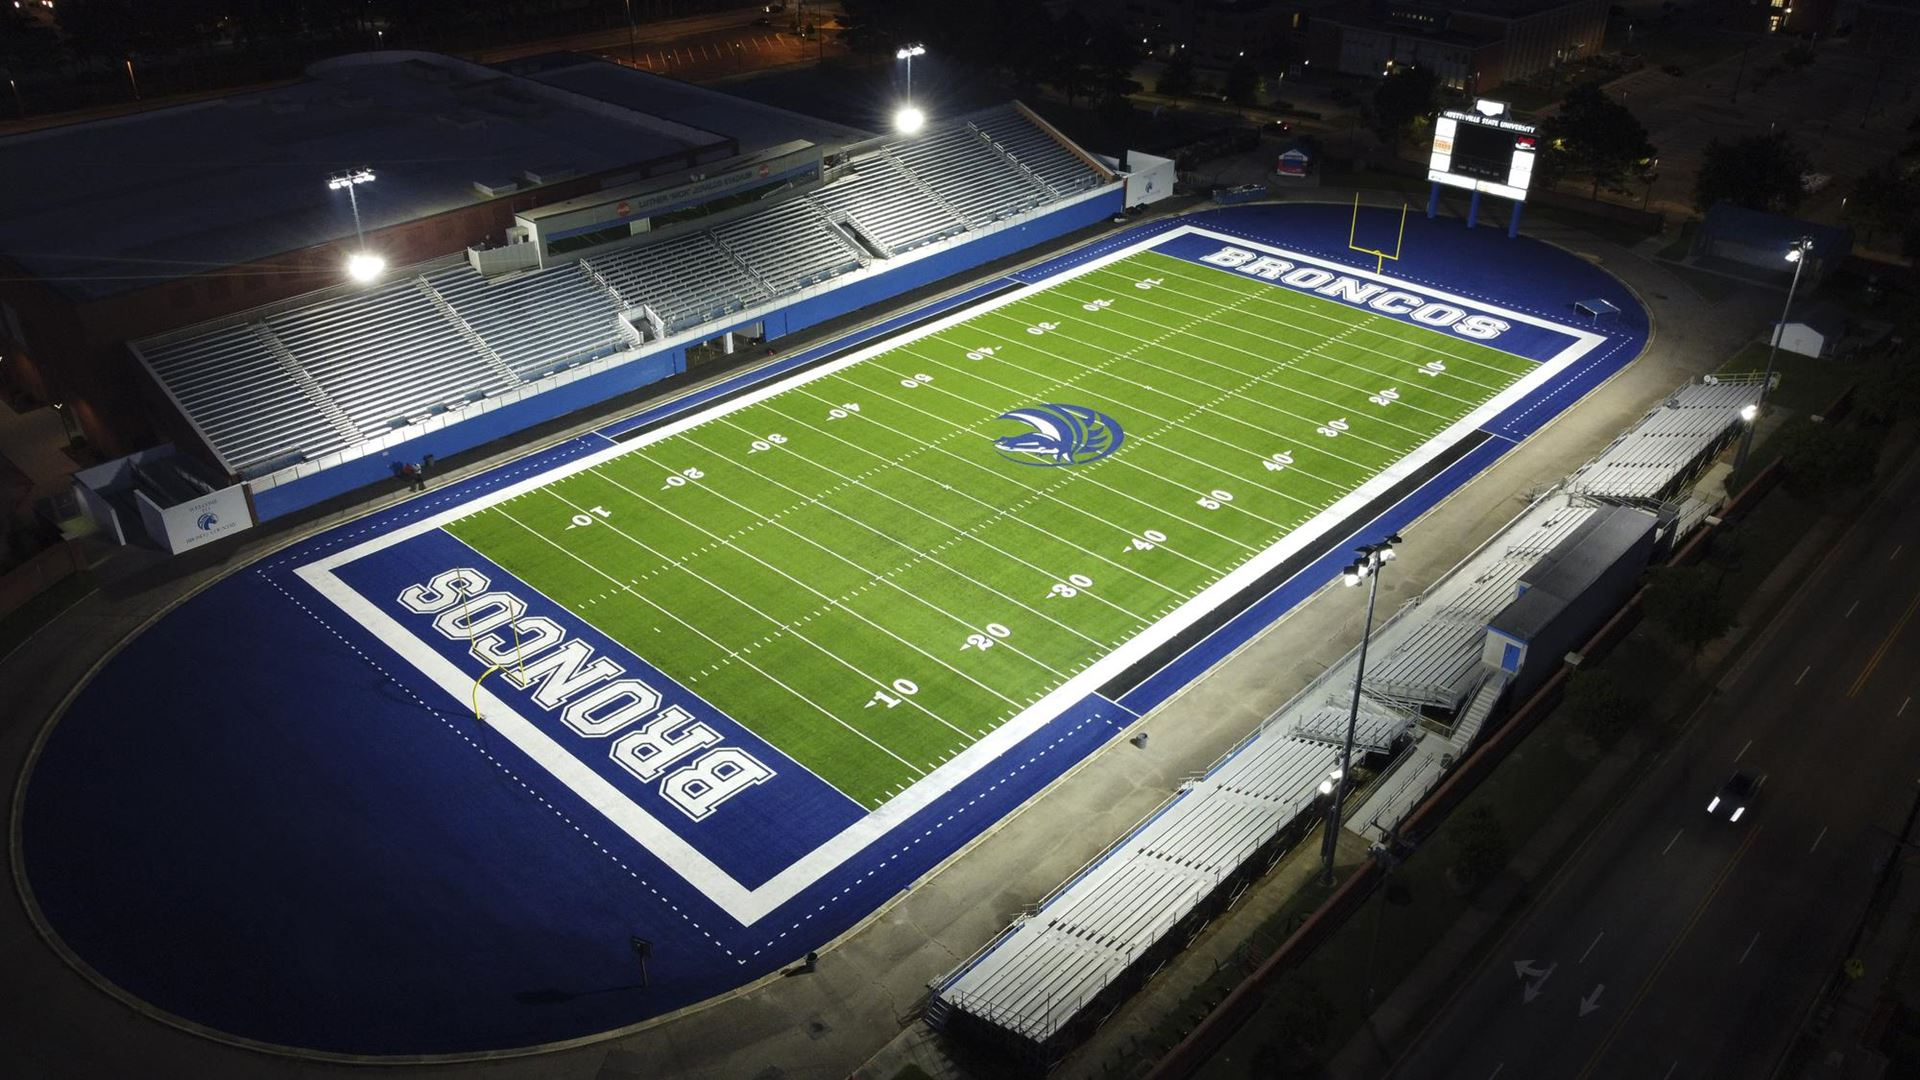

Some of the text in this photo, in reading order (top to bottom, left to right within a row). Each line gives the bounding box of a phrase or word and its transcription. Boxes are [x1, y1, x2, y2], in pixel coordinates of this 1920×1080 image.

[1481, 117, 1499, 127] STATE
[1500, 121, 1536, 133] UNIVERSITY
[1135, 279, 1160, 290] 10
[1199, 246, 1511, 340] BRONCOS
[1083, 300, 1112, 312] 20
[1027, 322, 1057, 335] 30
[967, 346, 994, 361] 40
[1418, 360, 1447, 377] 10
[901, 373, 934, 389] 50
[1369, 390, 1400, 407] 20
[830, 401, 861, 419] 40
[1317, 420, 1350, 438] 30
[752, 433, 788, 452] 30
[1262, 453, 1295, 472] 40
[666, 467, 704, 488] 20
[1196, 489, 1234, 511] 50
[572, 505, 612, 527] 10
[1130, 530, 1168, 552] 40
[1052, 574, 1093, 598] 30
[968, 623, 1011, 652] 20
[397, 567, 778, 823] BRONCOS
[874, 678, 919, 709] 10
